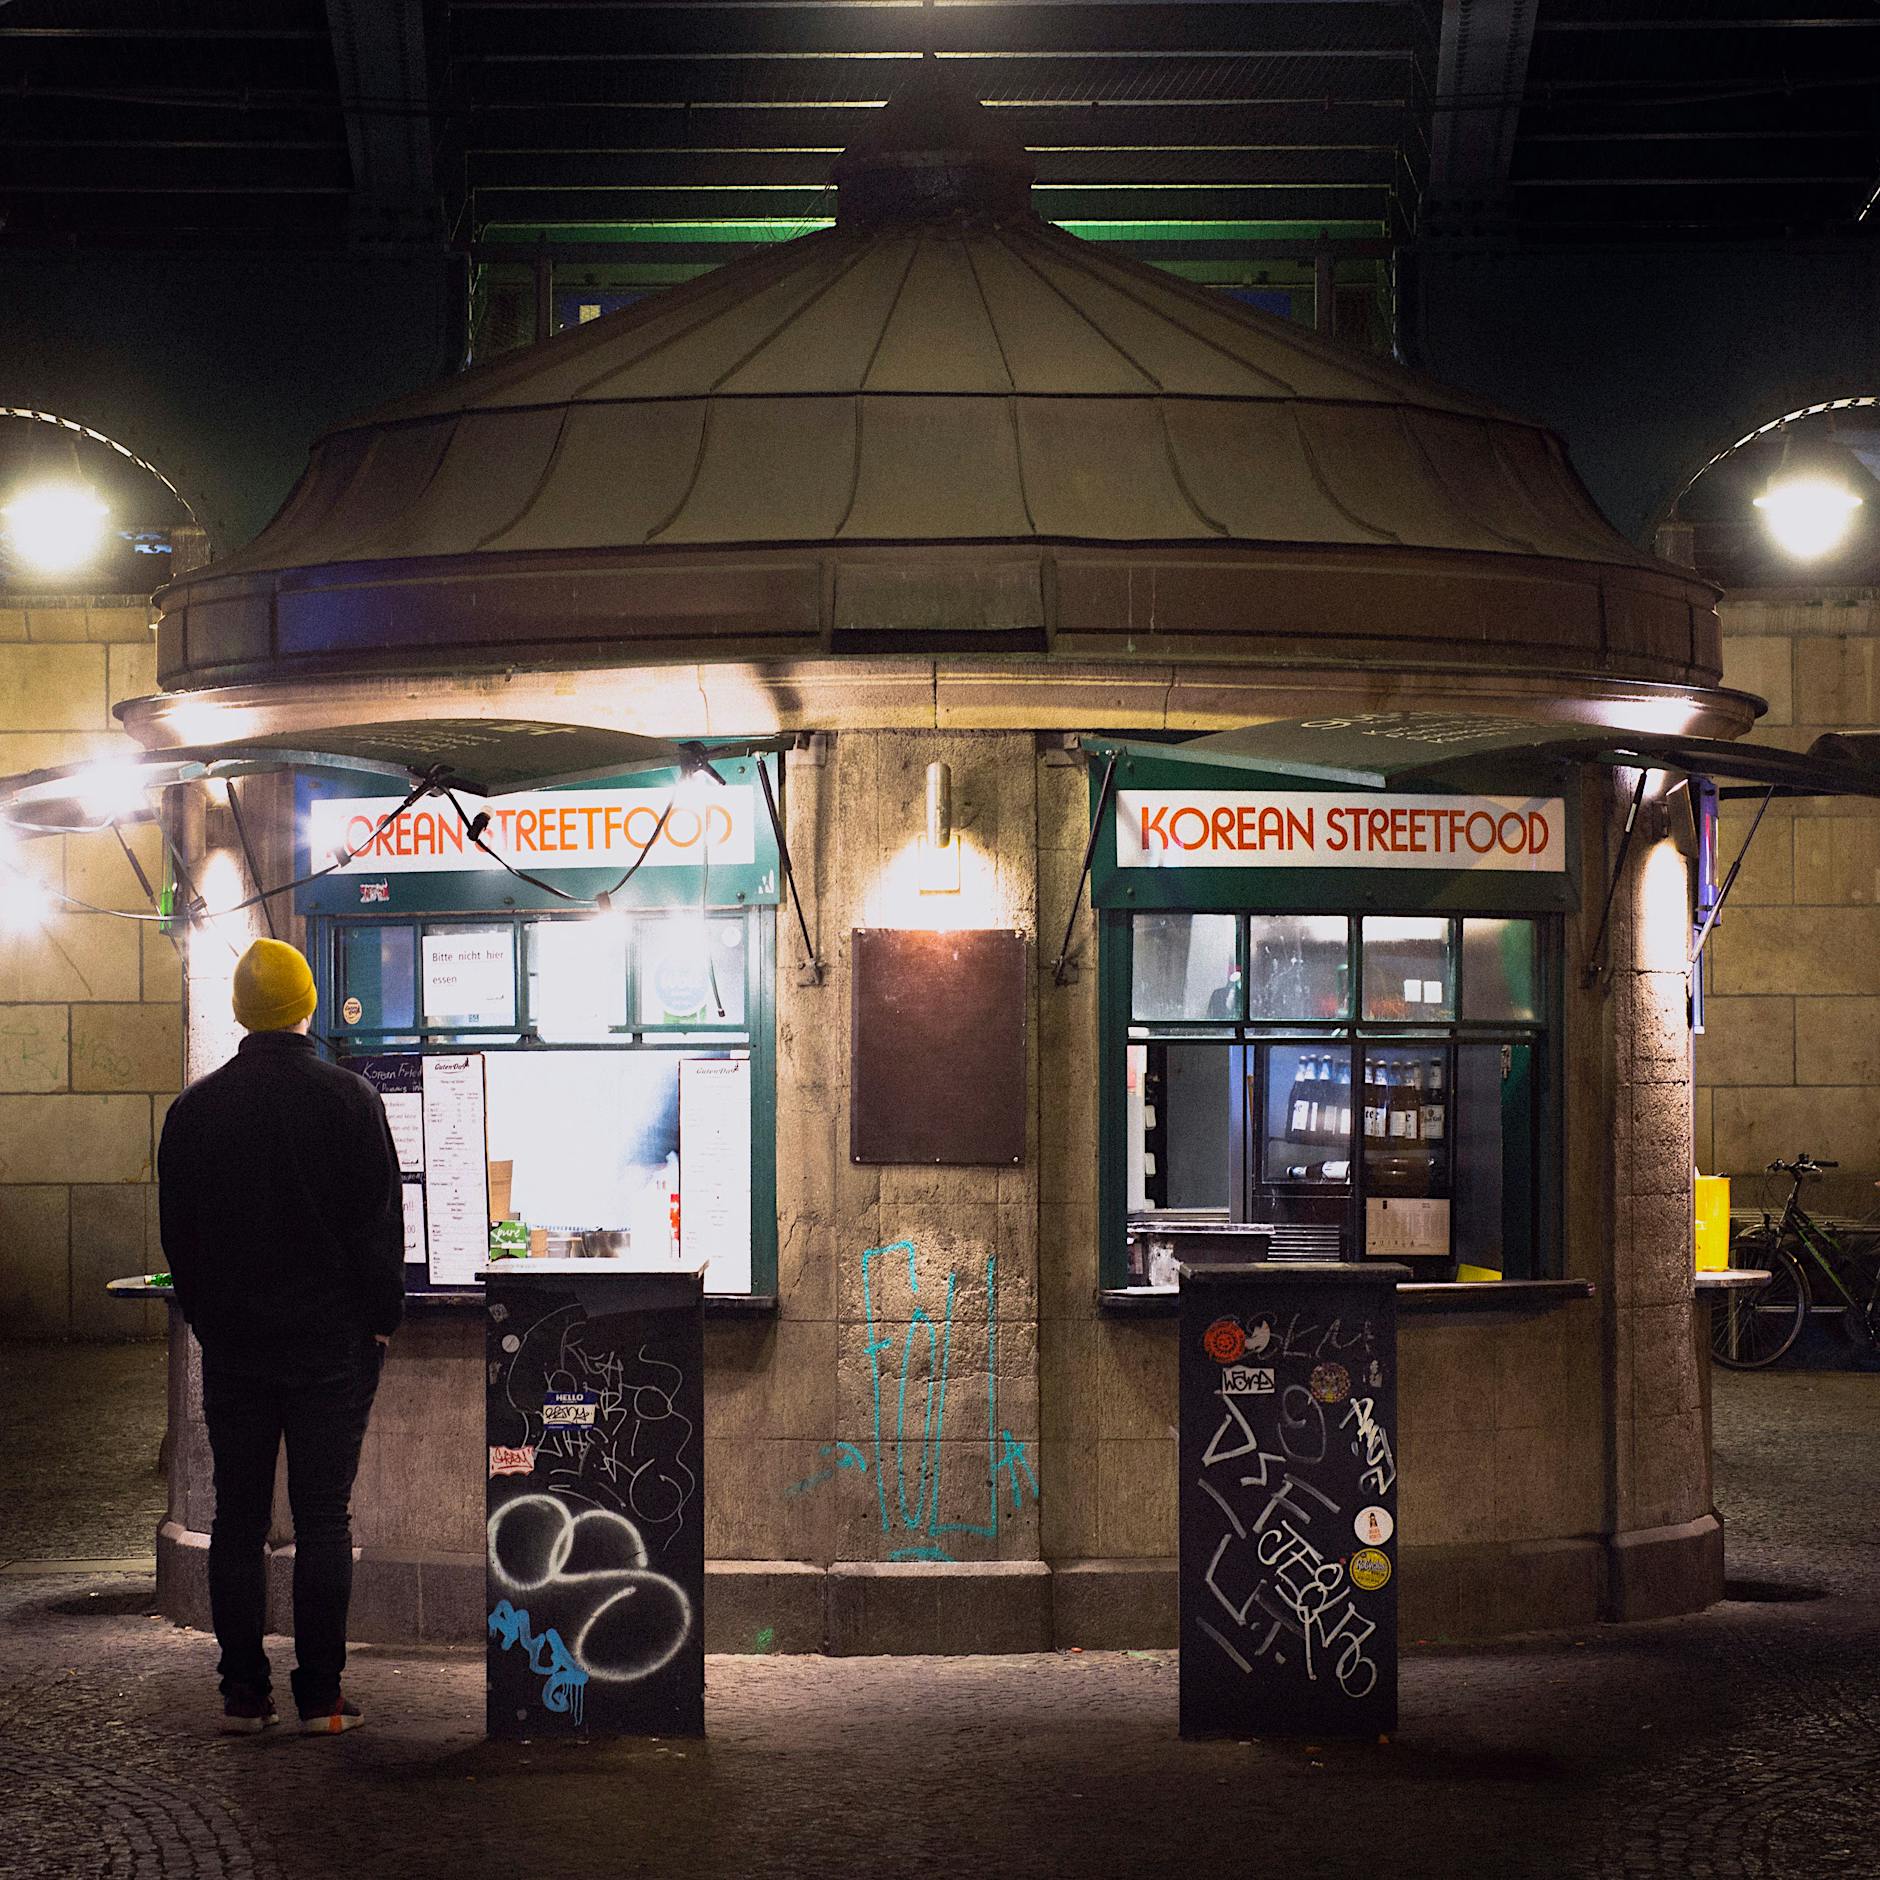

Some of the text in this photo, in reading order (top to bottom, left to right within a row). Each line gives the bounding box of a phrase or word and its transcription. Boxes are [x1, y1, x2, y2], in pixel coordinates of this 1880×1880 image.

[326, 810, 463, 858] OREAN
[1142, 806, 1549, 855] KOREAN STREETFOOD
[432, 949, 504, 962] Bitte nicht hier
[432, 975, 457, 985] essen
[555, 1393, 584, 1401] HELLO
